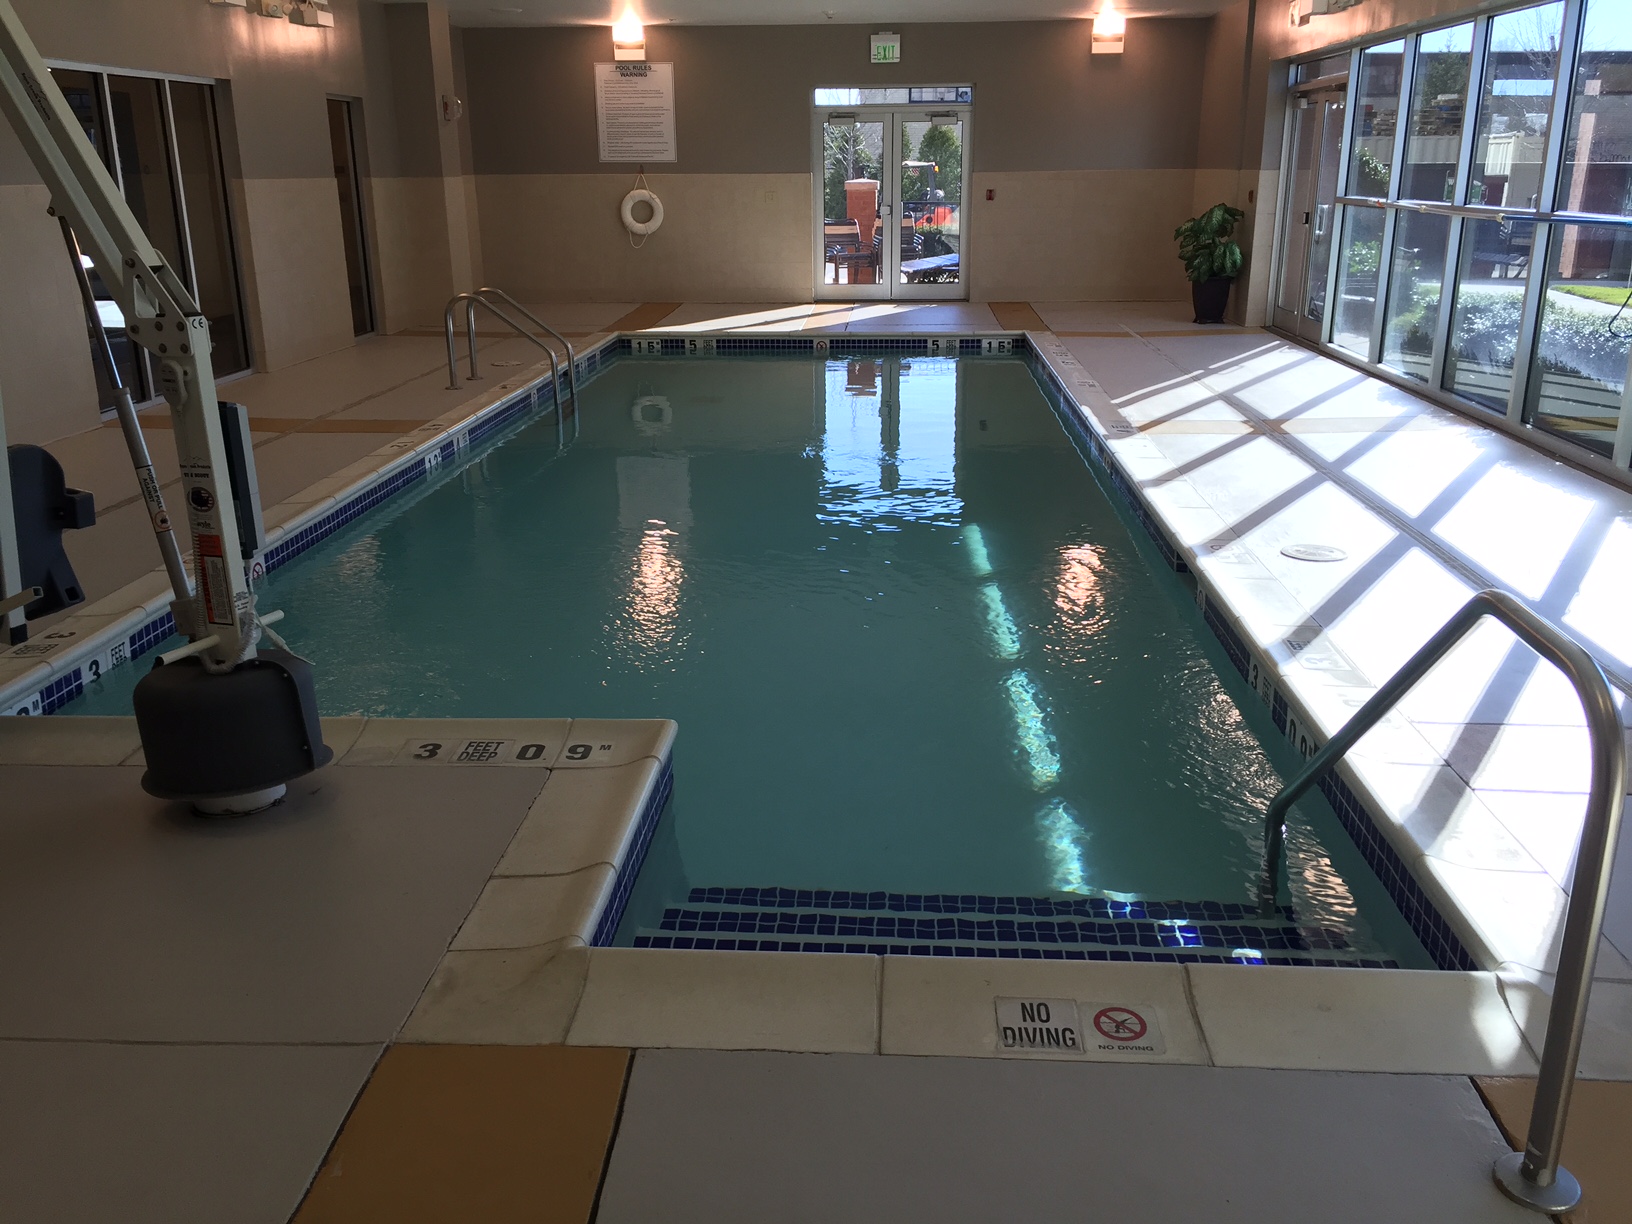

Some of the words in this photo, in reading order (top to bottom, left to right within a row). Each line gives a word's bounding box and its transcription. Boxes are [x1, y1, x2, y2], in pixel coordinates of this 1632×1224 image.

[876, 45, 896, 61] EXIT
[142, 478, 155, 503] AGAINST
[146, 468, 155, 485] PUSH
[154, 494, 164, 510] PULL
[88, 659, 102, 684] 3
[1250, 663, 1259, 690] 3
[412, 743, 443, 760] 3
[456, 751, 499, 762] DEEP
[466, 741, 505, 752] FEET
[1020, 1002, 1051, 1024] NO
[1002, 1026, 1077, 1049] DIVING
